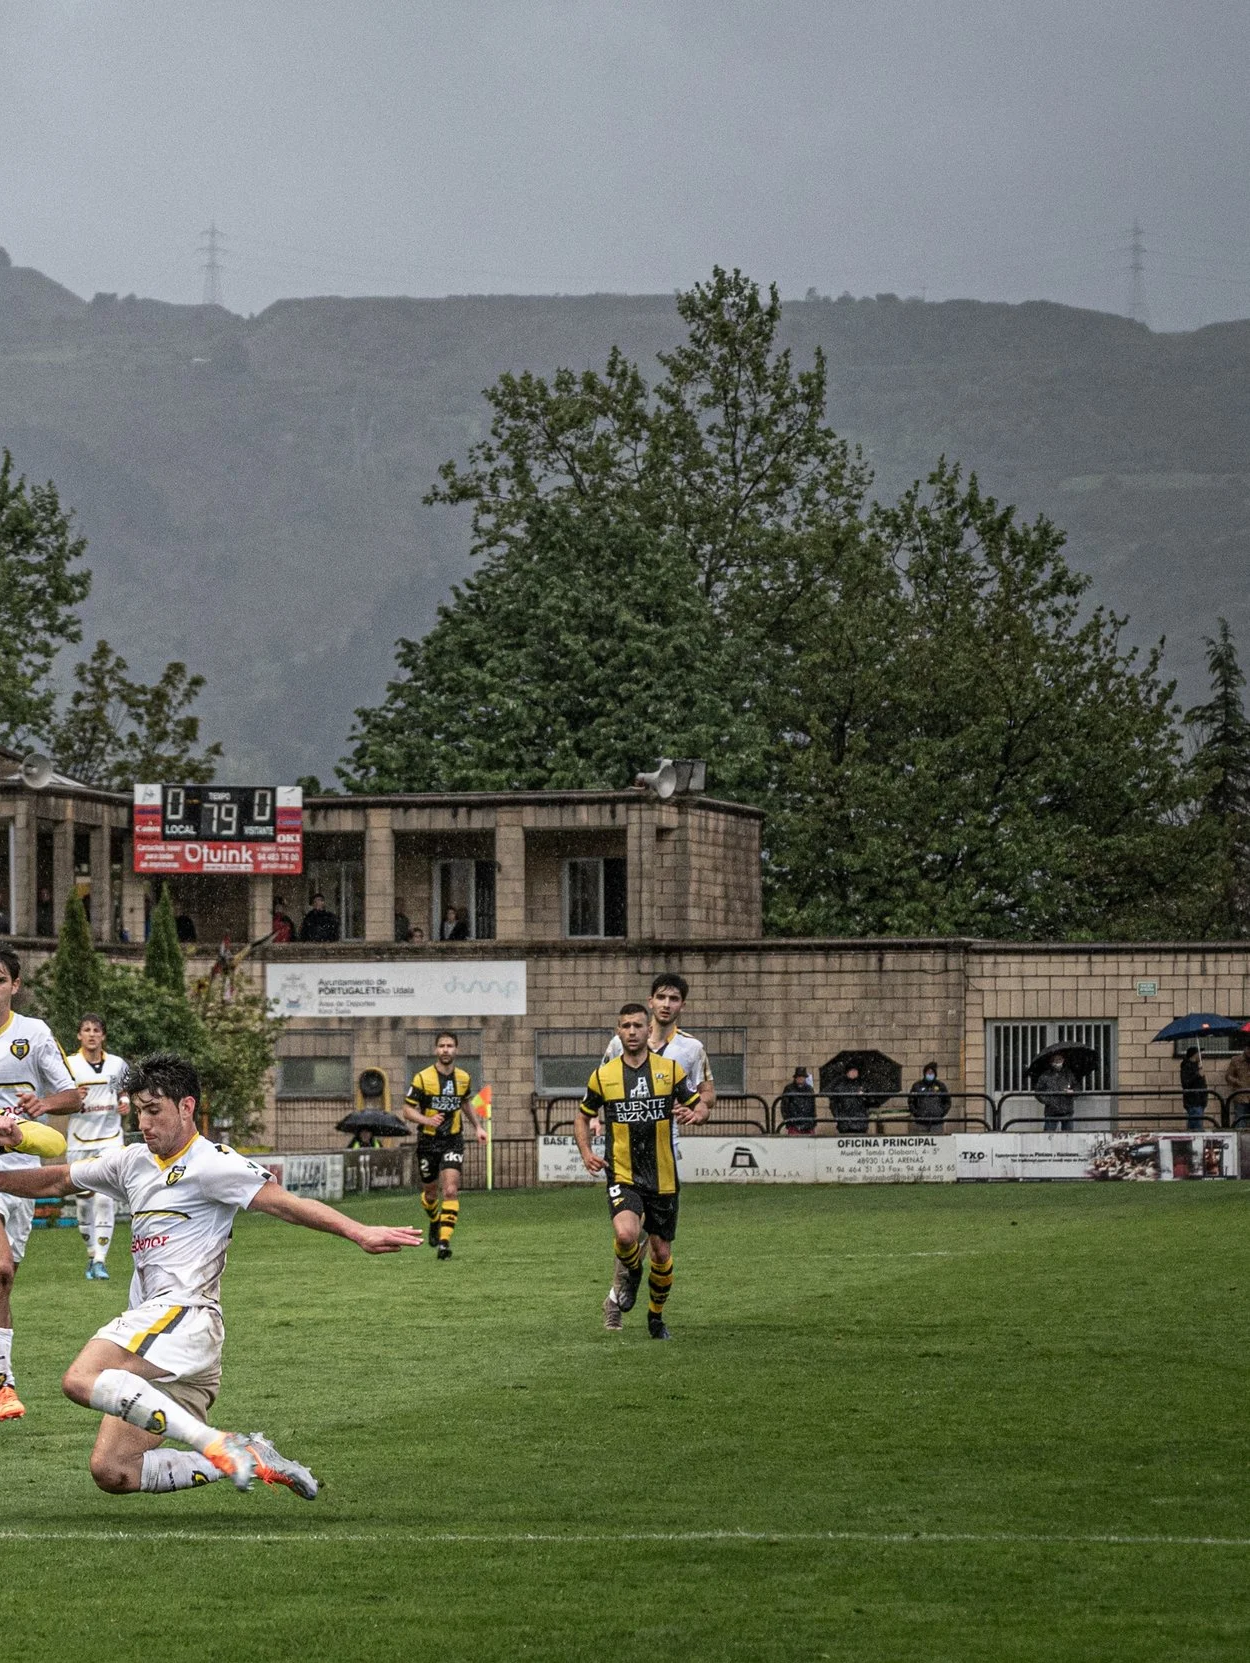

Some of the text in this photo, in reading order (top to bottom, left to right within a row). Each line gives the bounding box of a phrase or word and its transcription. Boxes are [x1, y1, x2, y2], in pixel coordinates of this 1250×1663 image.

[167, 788, 185, 819] 0
[253, 789, 271, 821] 0
[203, 803, 238, 835] 79
[165, 825, 197, 835] LOCAL
[318, 978, 387, 986] Ayuntamiento de
[615, 1098, 666, 1112] PUENTE
[617, 1109, 665, 1122] BIZKAIA
[543, 1137, 569, 1145] BASE
[837, 1138, 937, 1148] OFICINA PRINCIPAL
[962, 1151, 985, 1160] TXO
[420, 1159, 430, 1171] 2
